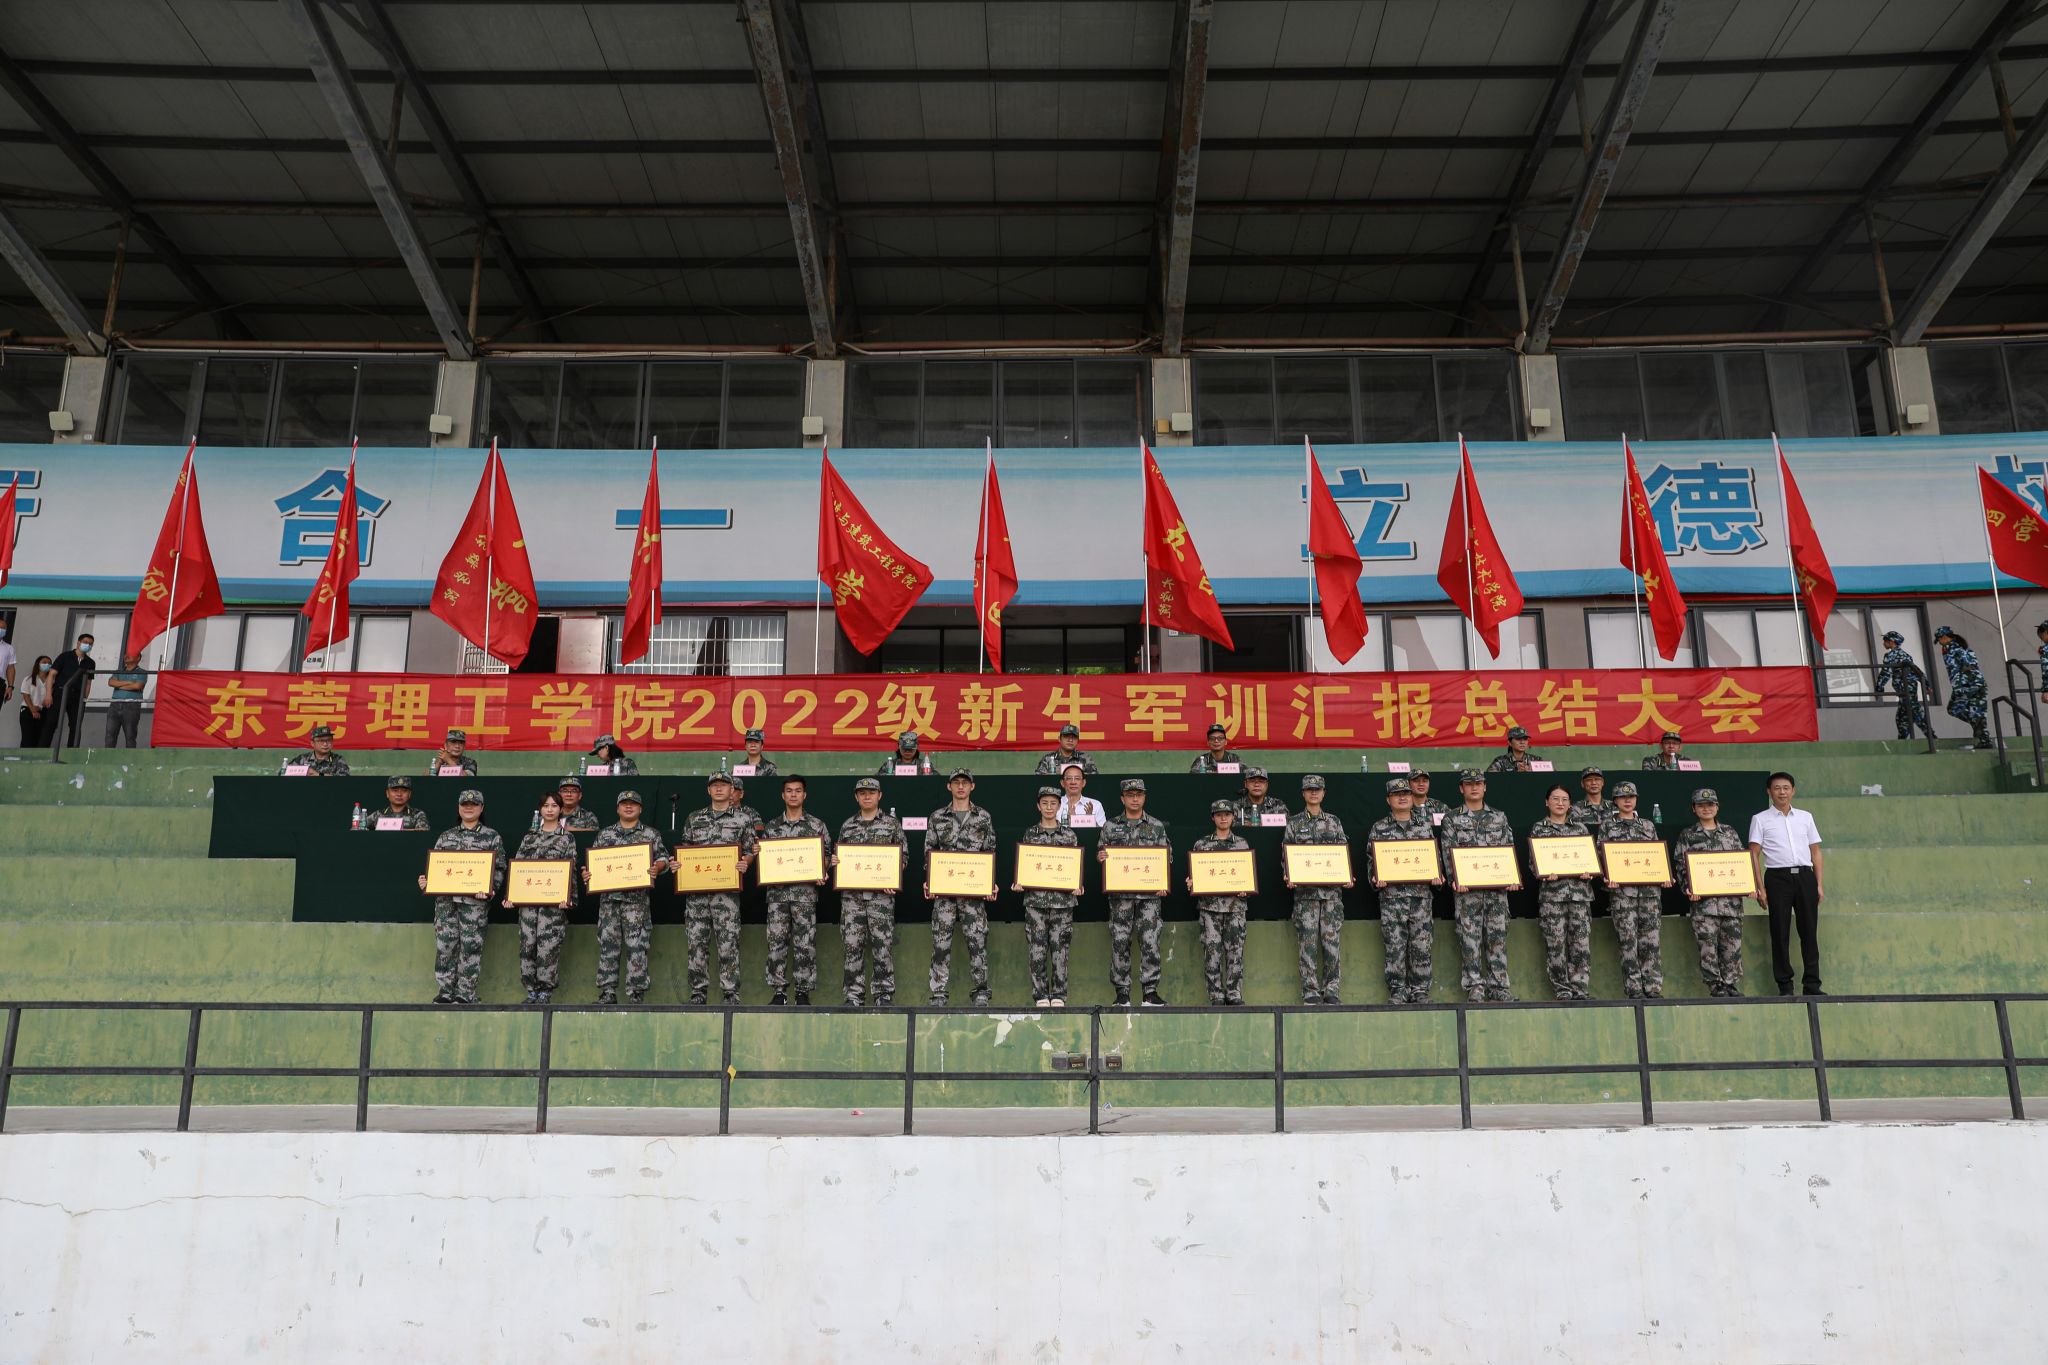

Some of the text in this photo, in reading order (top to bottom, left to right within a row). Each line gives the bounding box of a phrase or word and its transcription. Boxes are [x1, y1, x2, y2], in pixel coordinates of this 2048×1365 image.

[203, 676, 1763, 741] 东莞理工学院2022级新生军训汇报总结大会
